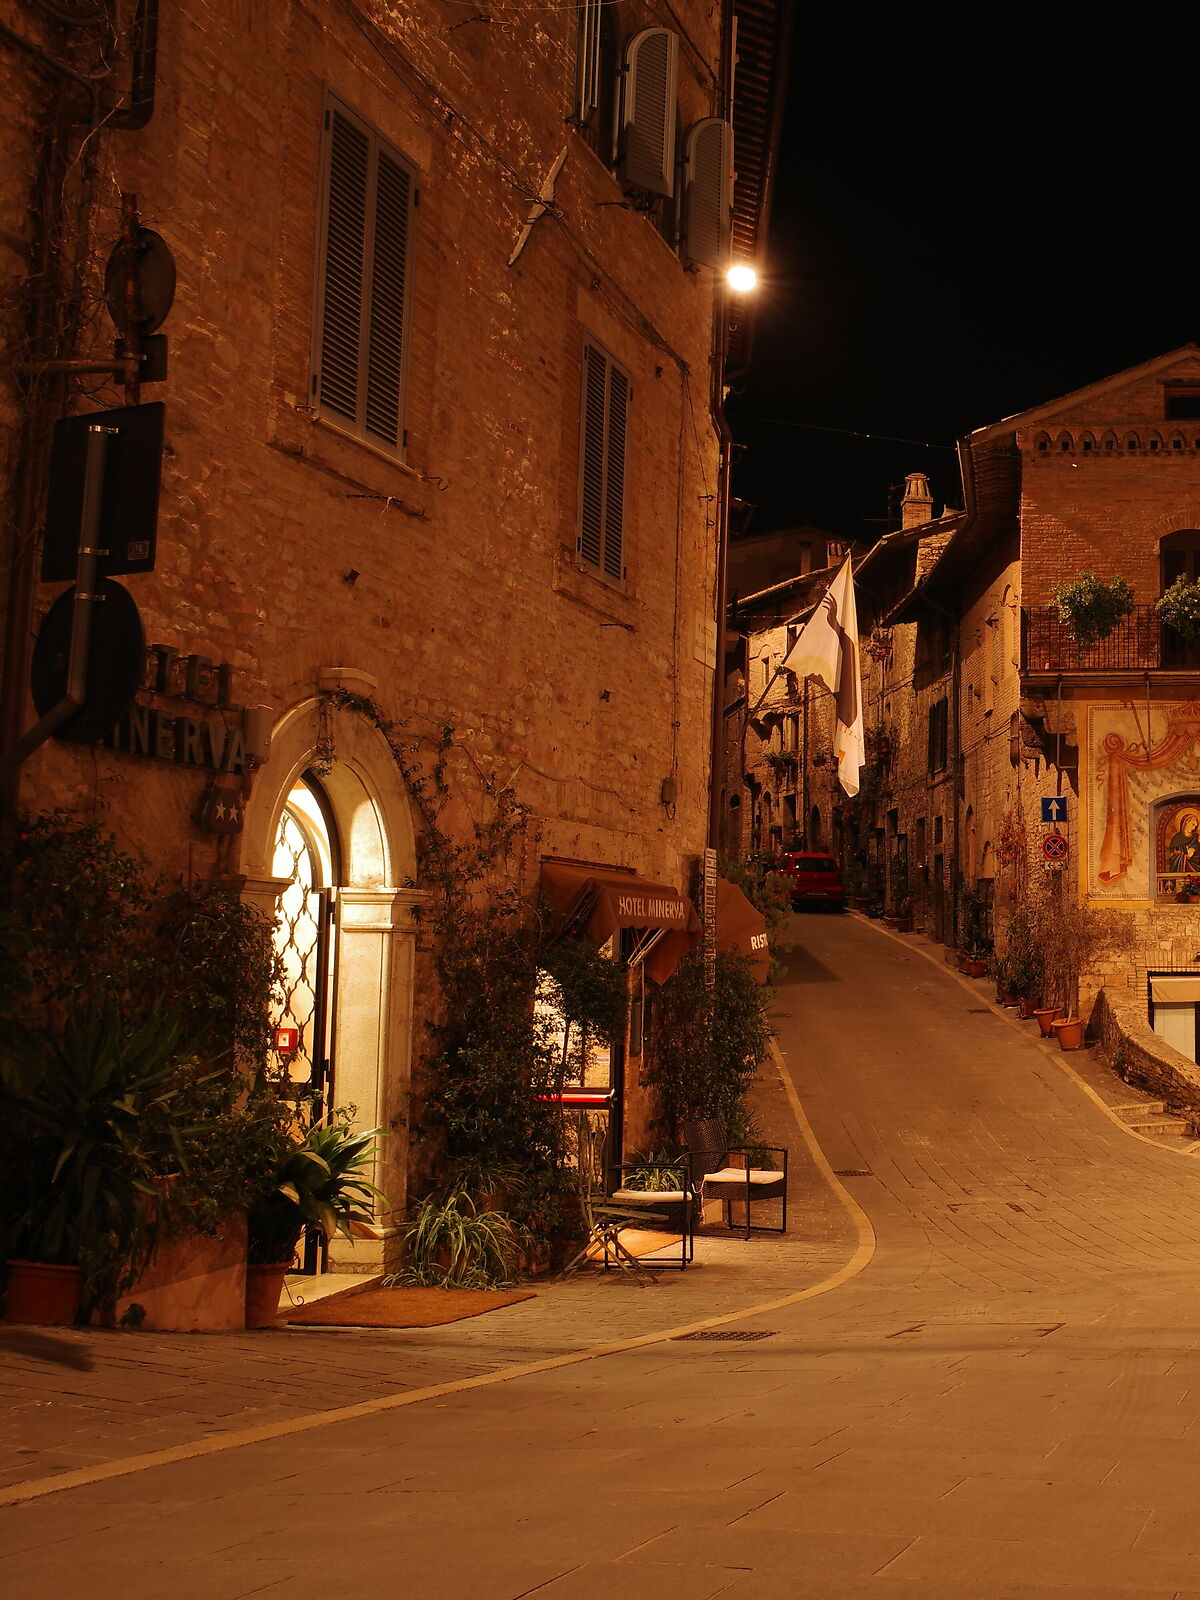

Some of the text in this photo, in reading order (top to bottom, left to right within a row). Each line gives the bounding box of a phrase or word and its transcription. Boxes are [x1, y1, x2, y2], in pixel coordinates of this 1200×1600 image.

[152, 644, 239, 711] TEL
[111, 706, 248, 775] INERVA
[618, 896, 685, 919] HOTEL MINERVA
